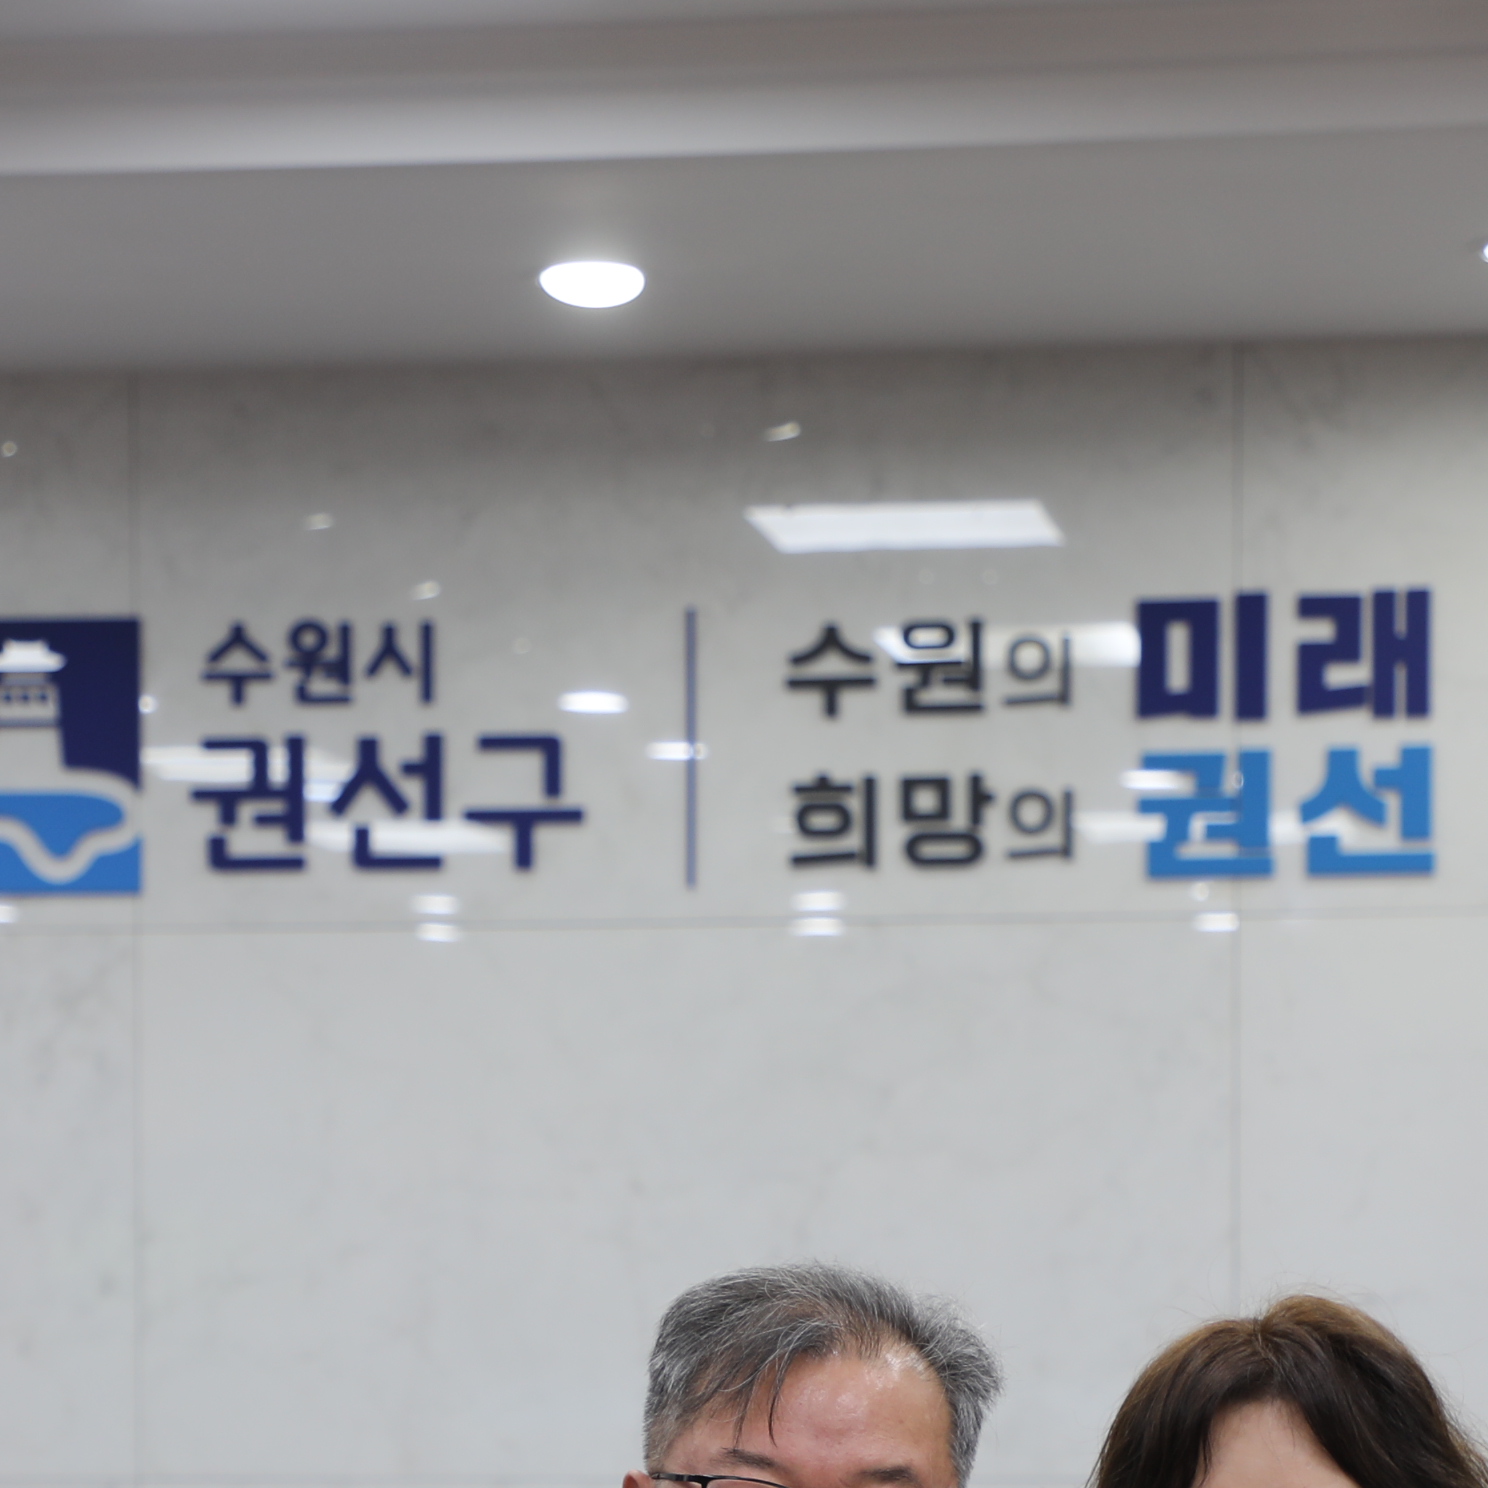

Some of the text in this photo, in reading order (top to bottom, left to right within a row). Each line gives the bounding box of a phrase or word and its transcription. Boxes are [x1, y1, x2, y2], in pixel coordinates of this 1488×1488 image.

[202, 618, 437, 706] 수원시
[786, 587, 1432, 721] 수원의 미래
[192, 733, 585, 871] 권선구
[789, 744, 1436, 880] 희망의 권선
